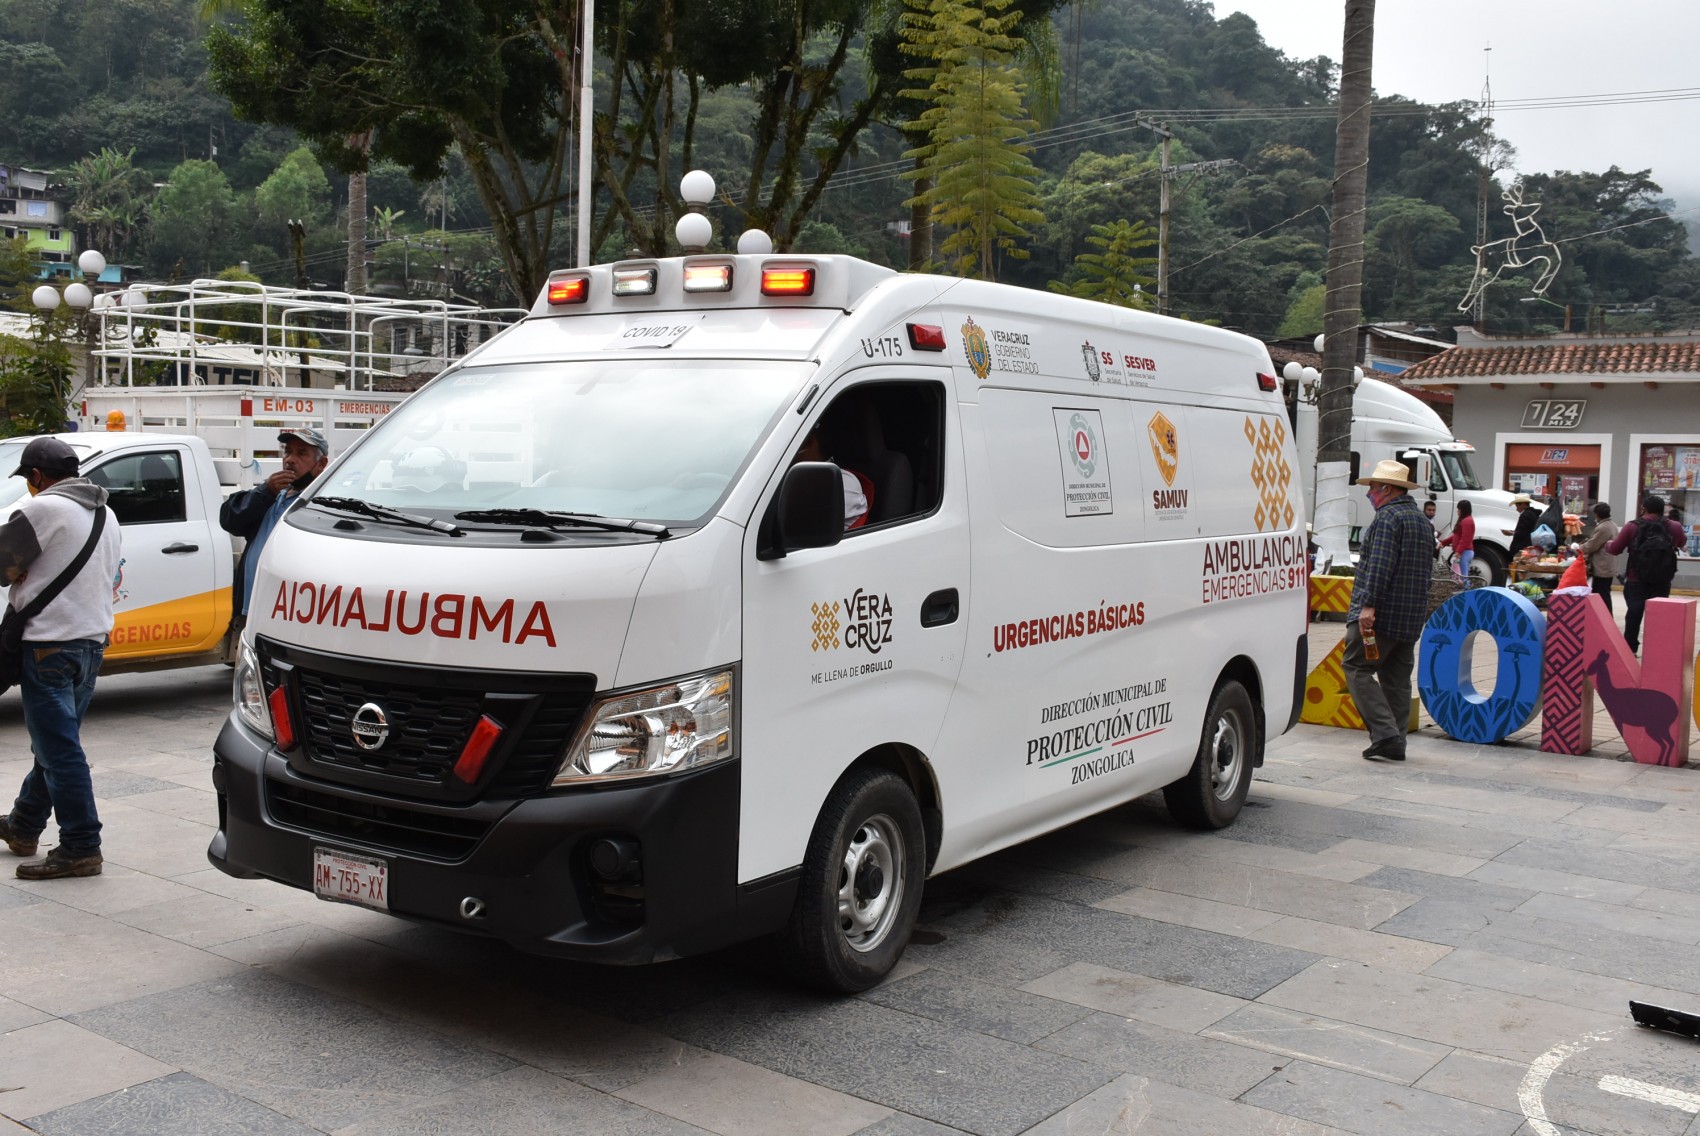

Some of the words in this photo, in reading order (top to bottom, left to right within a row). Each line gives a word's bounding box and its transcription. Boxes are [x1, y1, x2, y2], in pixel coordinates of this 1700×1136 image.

[623, 326, 669, 338] COVID
[668, 325, 687, 336] 19
[991, 329, 1030, 346] VERACRUZ
[861, 337, 902, 358] U-175
[995, 344, 1031, 360] GOBIERNO
[997, 359, 1011, 372] DEL
[1012, 360, 1040, 374] ESTADO
[1101, 351, 1113, 365] SS
[1124, 355, 1156, 371] SESVER
[263, 398, 314, 413] EM-03
[340, 402, 391, 415] EMERGENCIAS
[1550, 404, 1580, 420] 24
[1066, 491, 1097, 501] PROTECCIÓN
[1098, 492, 1110, 500] CIVIL
[1153, 489, 1188, 509] SAMUV
[1203, 536, 1305, 576] AMBULANCIA
[1203, 568, 1286, 603] EMERGENCIAS
[1288, 567, 1305, 589] 911
[844, 588, 893, 618] VERA
[844, 618, 893, 654] CRUZ
[994, 614, 1084, 653] URGENCIAS
[1087, 600, 1145, 633] BÁSICAS
[811, 674, 822, 684] ME
[824, 669, 848, 682] LLENA
[849, 667, 859, 678] DE
[860, 659, 893, 675] ORGULLO
[1041, 692, 1100, 724] DIRECCIÓN
[1101, 683, 1153, 708] MUNICIPAL
[1154, 678, 1167, 694] DE
[352, 722, 382, 734] NISSAN
[1026, 708, 1133, 766] PROTECCIÓN
[1135, 701, 1173, 732] CIVIL
[1071, 748, 1135, 785] ZONGOLICA
[316, 864, 384, 901] AM-755-XX
